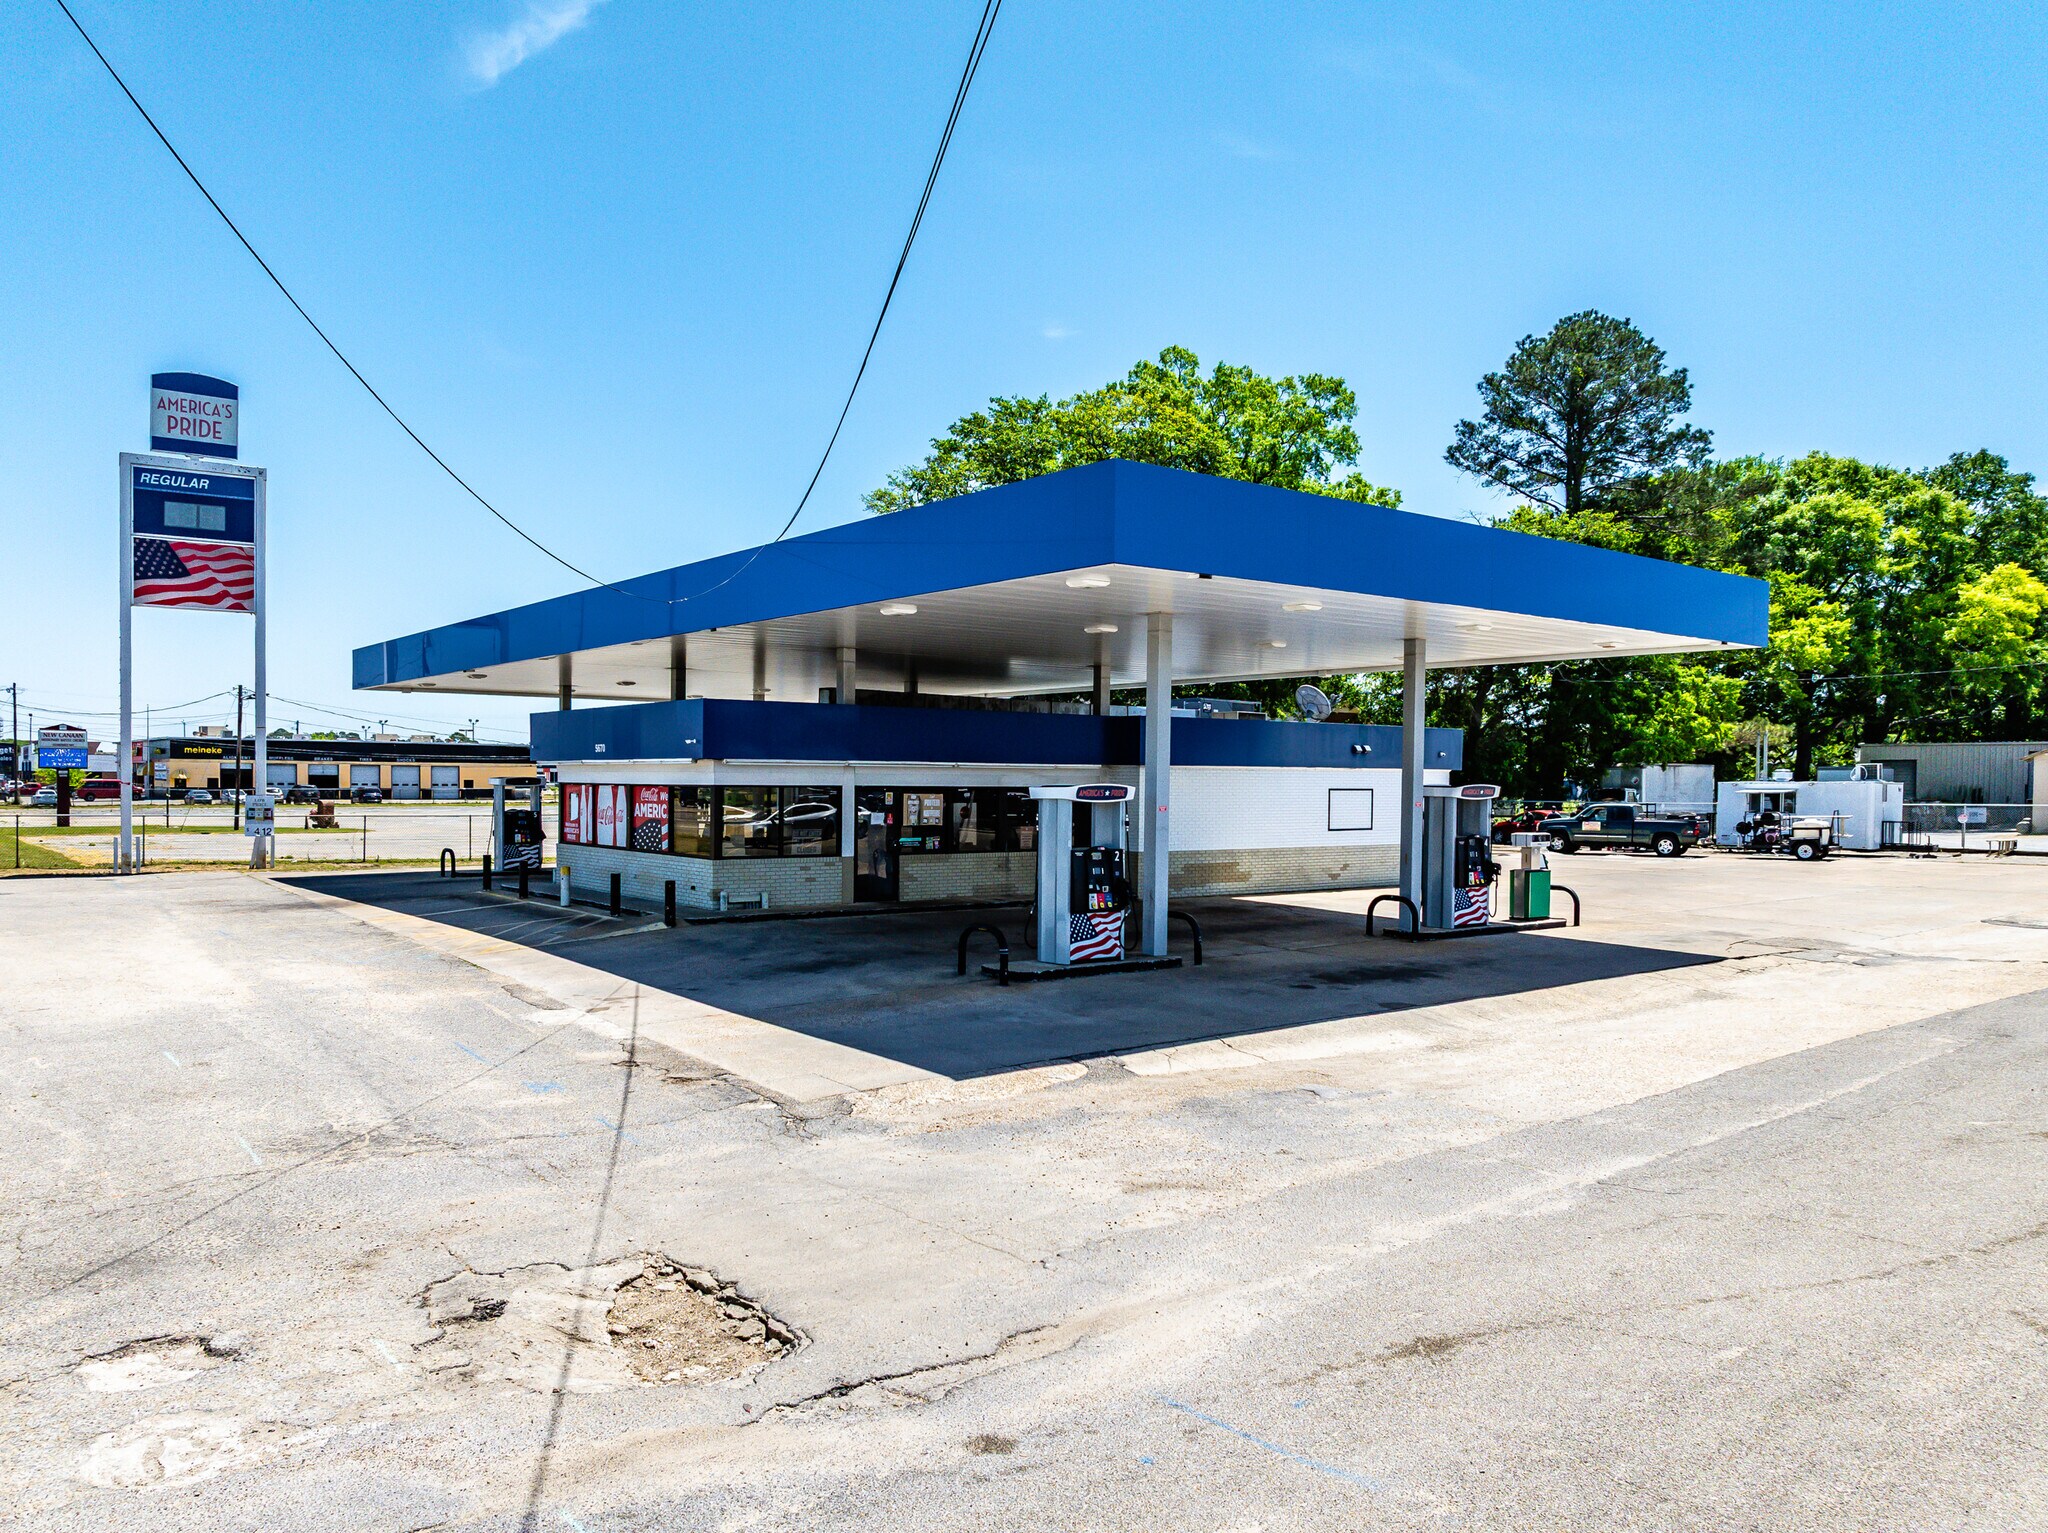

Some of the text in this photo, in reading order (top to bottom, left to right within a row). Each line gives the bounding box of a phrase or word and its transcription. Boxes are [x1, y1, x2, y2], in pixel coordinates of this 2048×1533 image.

[157, 396, 233, 419] AMERICA'S
[167, 415, 223, 440] PRIDE
[140, 472, 210, 490] REGULAR
[184, 746, 223, 754] meineke
[1078, 789, 1125, 797] AMERICA'S PRIDE
[634, 803, 668, 819] AMERIC
[1114, 850, 1120, 862] 2
